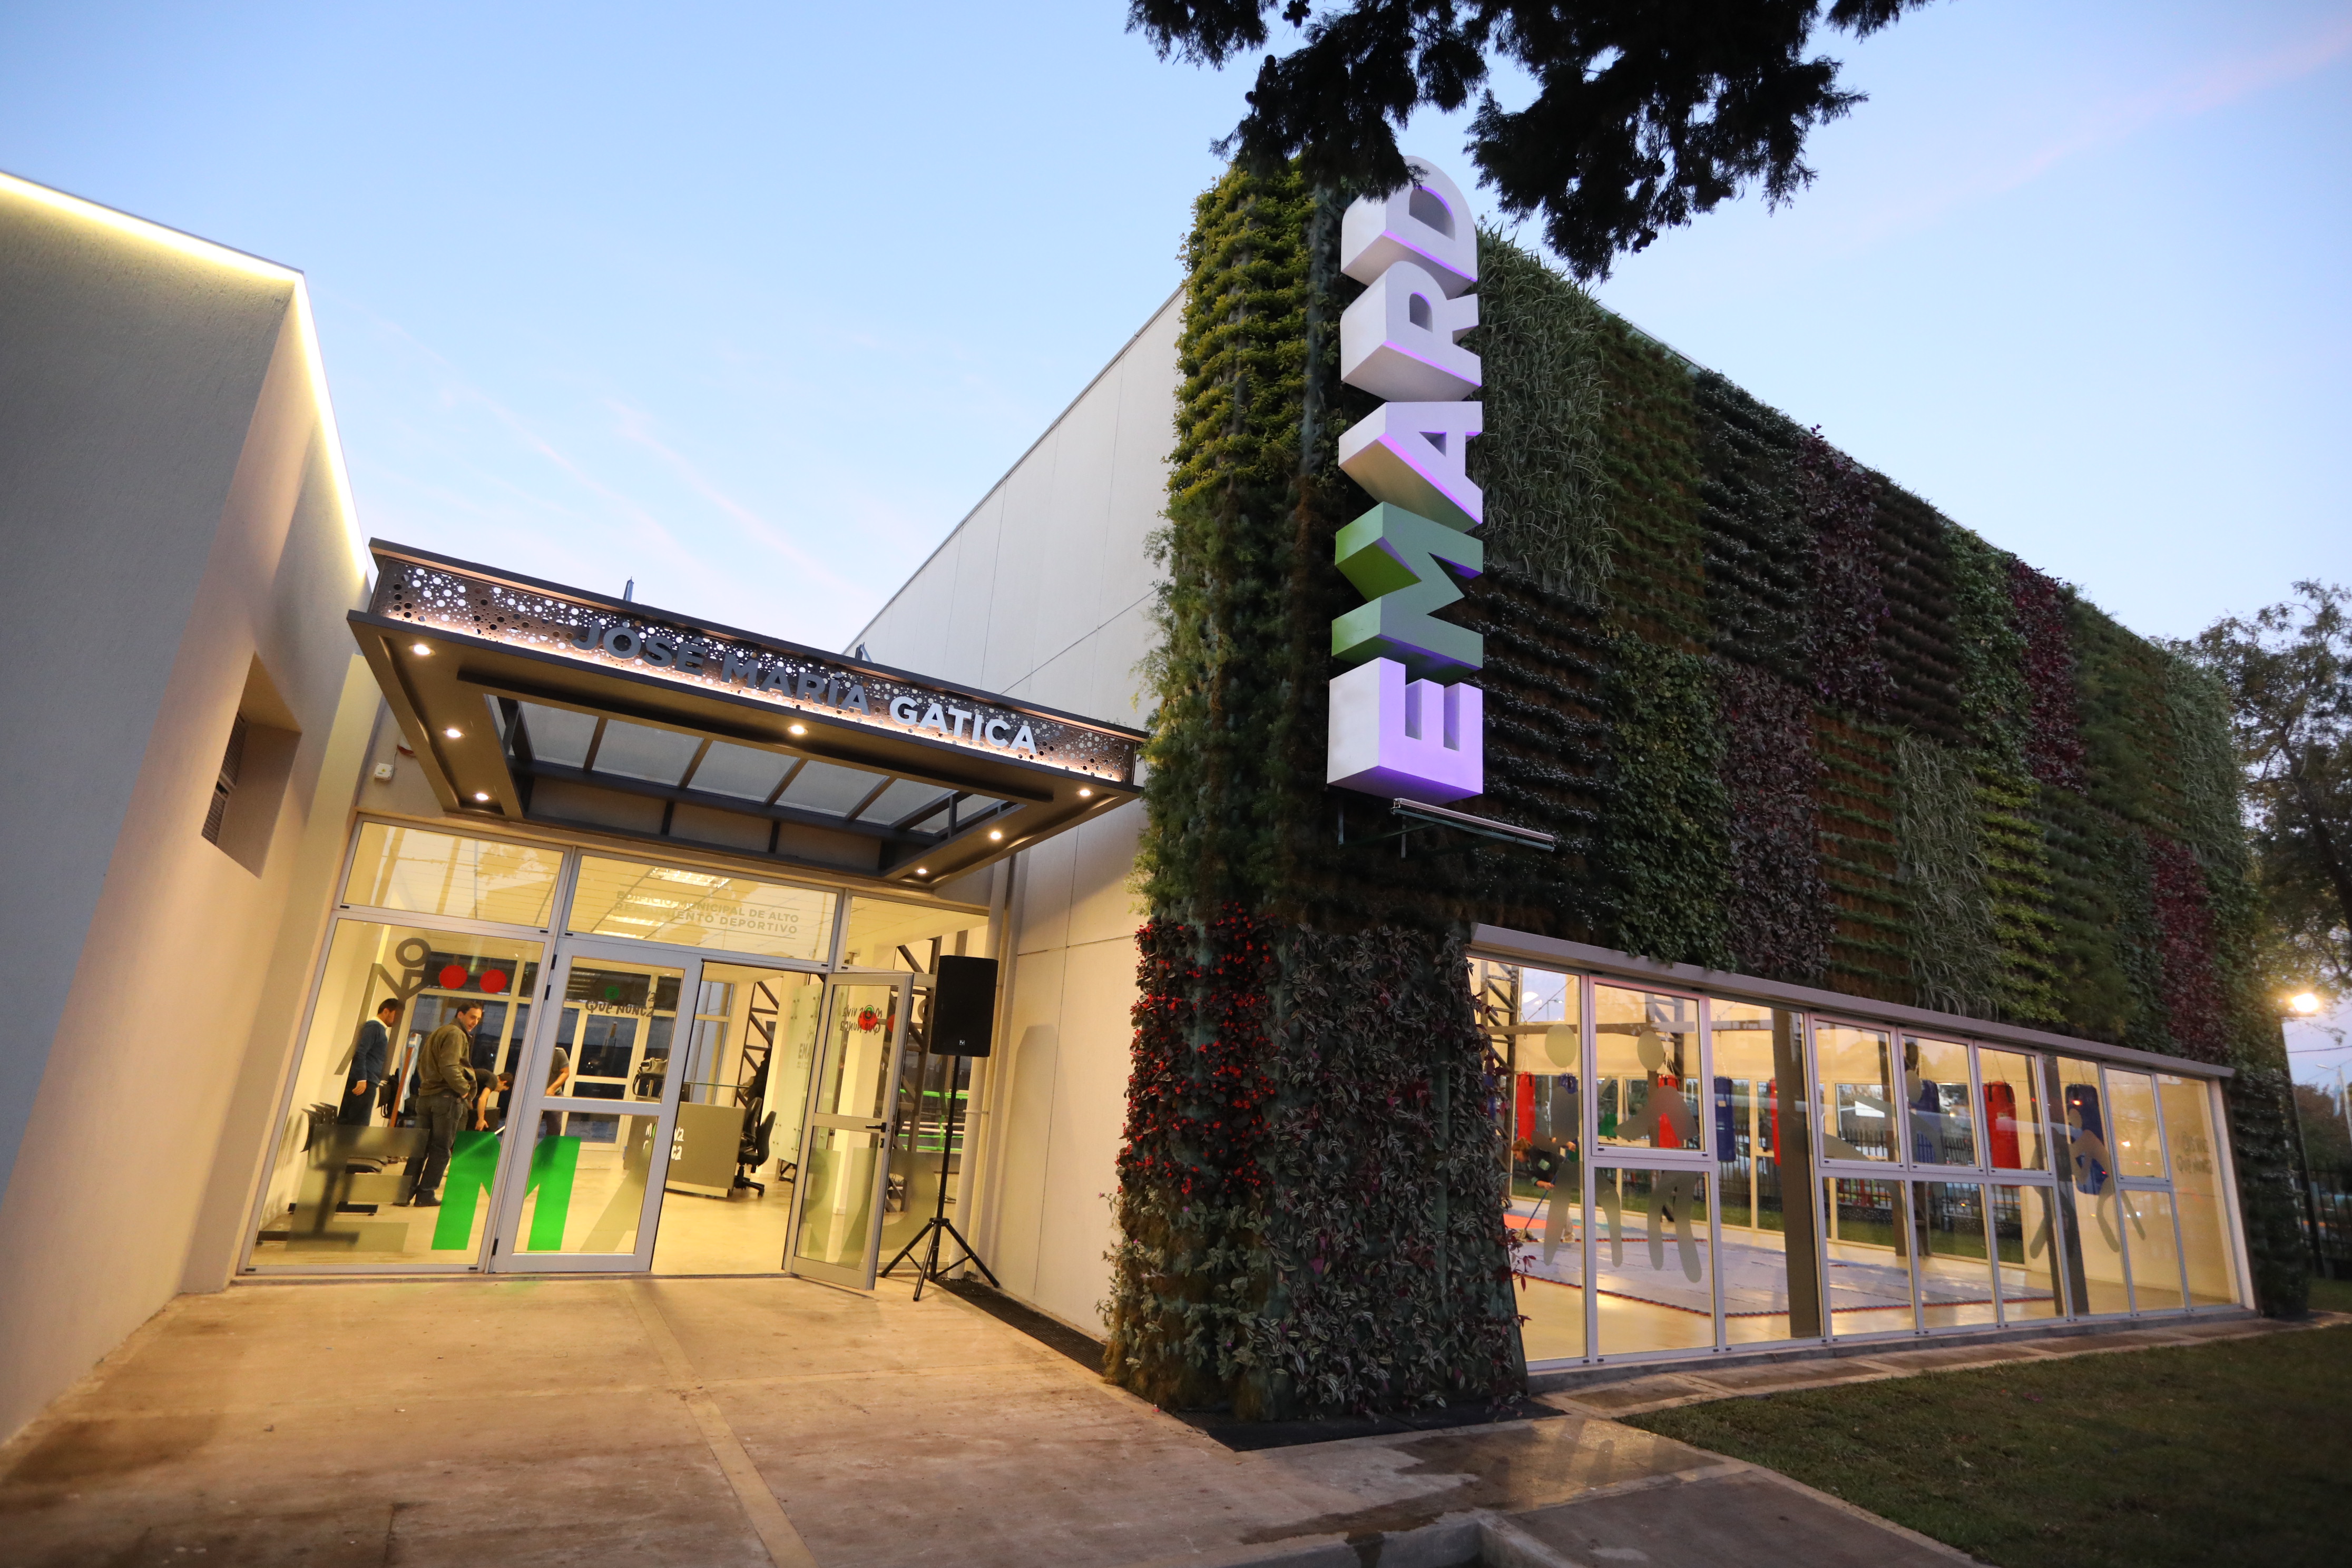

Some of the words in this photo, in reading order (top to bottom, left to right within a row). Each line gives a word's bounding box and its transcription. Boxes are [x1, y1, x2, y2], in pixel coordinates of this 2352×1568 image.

[1327, 154, 1483, 805] EMARD
[571, 622, 707, 677] JOSÉ
[720, 653, 870, 716] MARÍA
[889, 695, 1037, 754] GATICA
[616, 891, 673, 906] EDIFICIO
[678, 901, 745, 916] MUNICIPAL
[749, 909, 765, 918] DE
[768, 912, 799, 923] ALTO
[719, 916, 797, 934] DEPORTIVO
